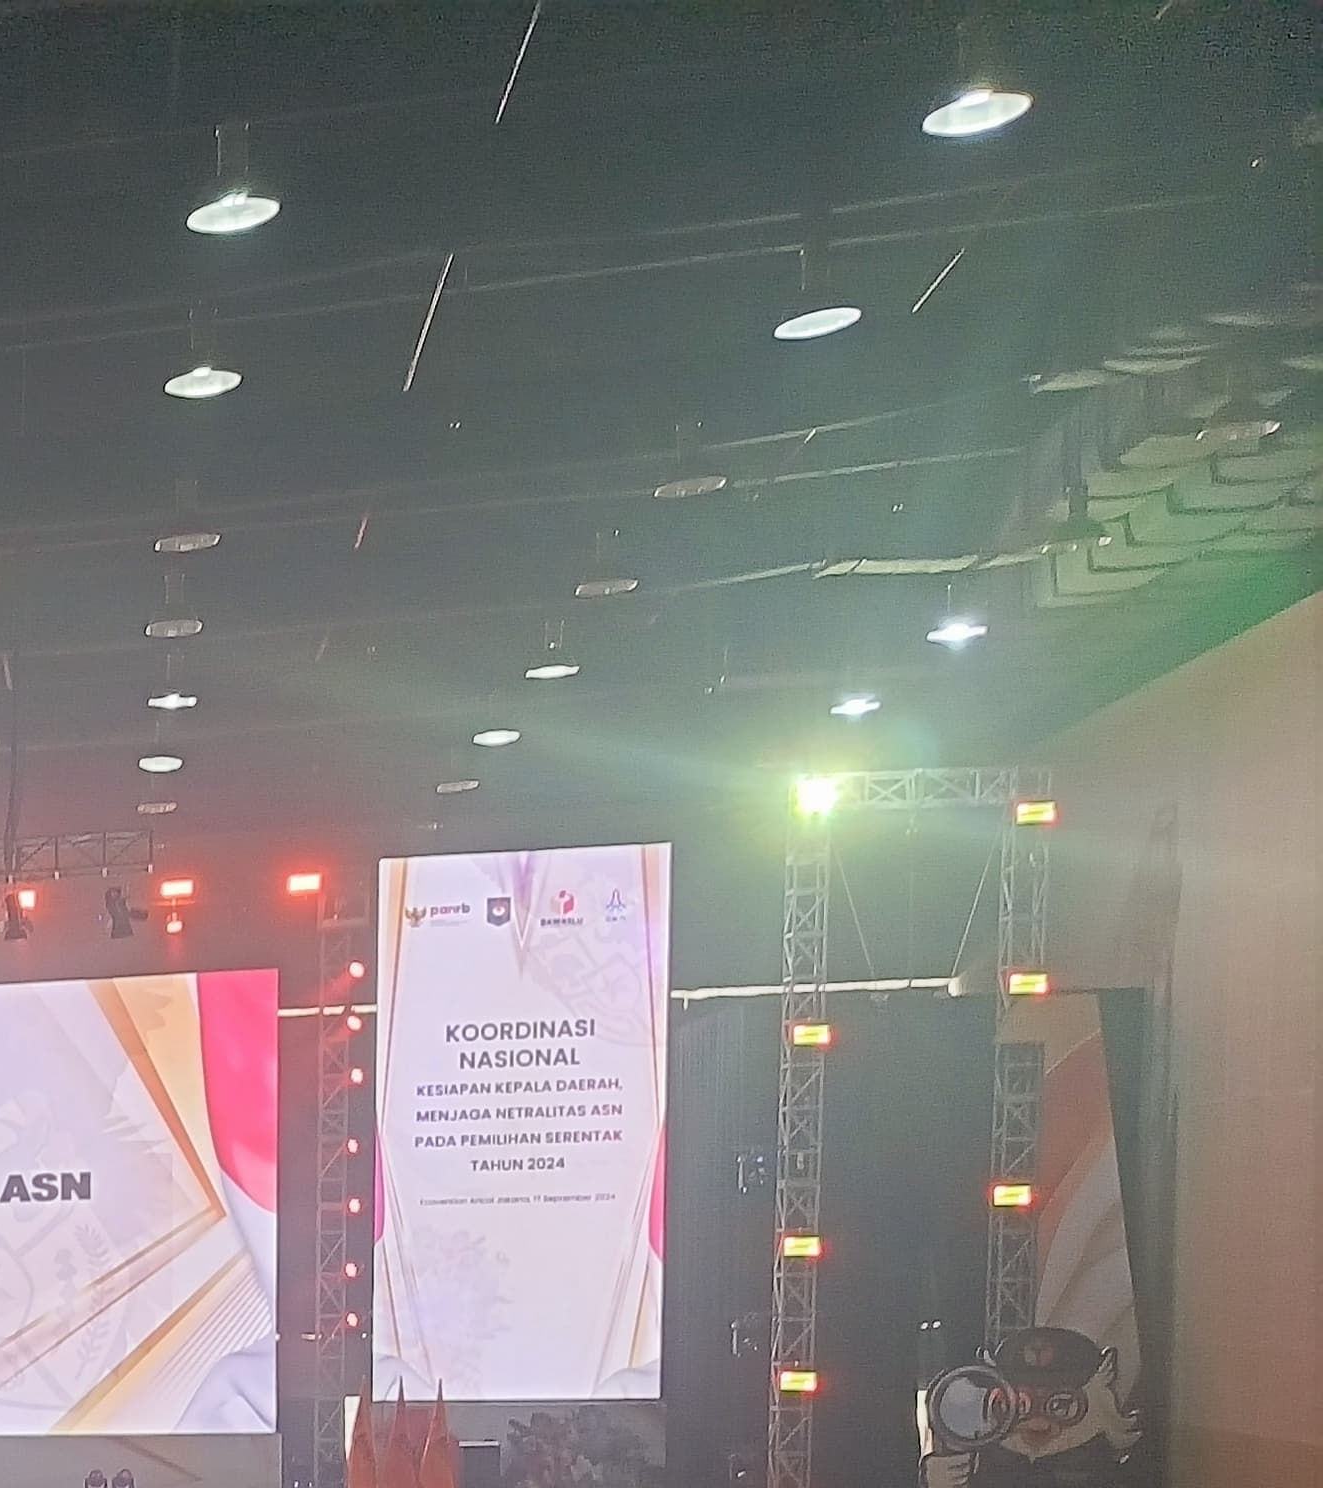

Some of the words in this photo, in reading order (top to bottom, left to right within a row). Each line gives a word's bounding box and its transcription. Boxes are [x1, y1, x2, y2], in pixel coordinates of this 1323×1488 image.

[430, 903, 470, 917] panrb
[445, 1019, 595, 1043] KOORDINASI
[459, 1048, 580, 1070] NASIONAL
[416, 1083, 491, 1096] KESIAPAN
[495, 1080, 552, 1094] KEPALA
[556, 1078, 623, 1092] DAERAH,
[416, 1108, 491, 1122] MENJAGA
[496, 1105, 586, 1120] NETRALITAS
[591, 1104, 623, 1116] ASN
[415, 1135, 456, 1148] PADA
[461, 1132, 541, 1146] PEMILIHAN
[545, 1130, 623, 1144] SERENTAK
[471, 1159, 523, 1171] TAHUN
[527, 1157, 565, 1170] 2024
[0, 1171, 93, 1204] ASN
